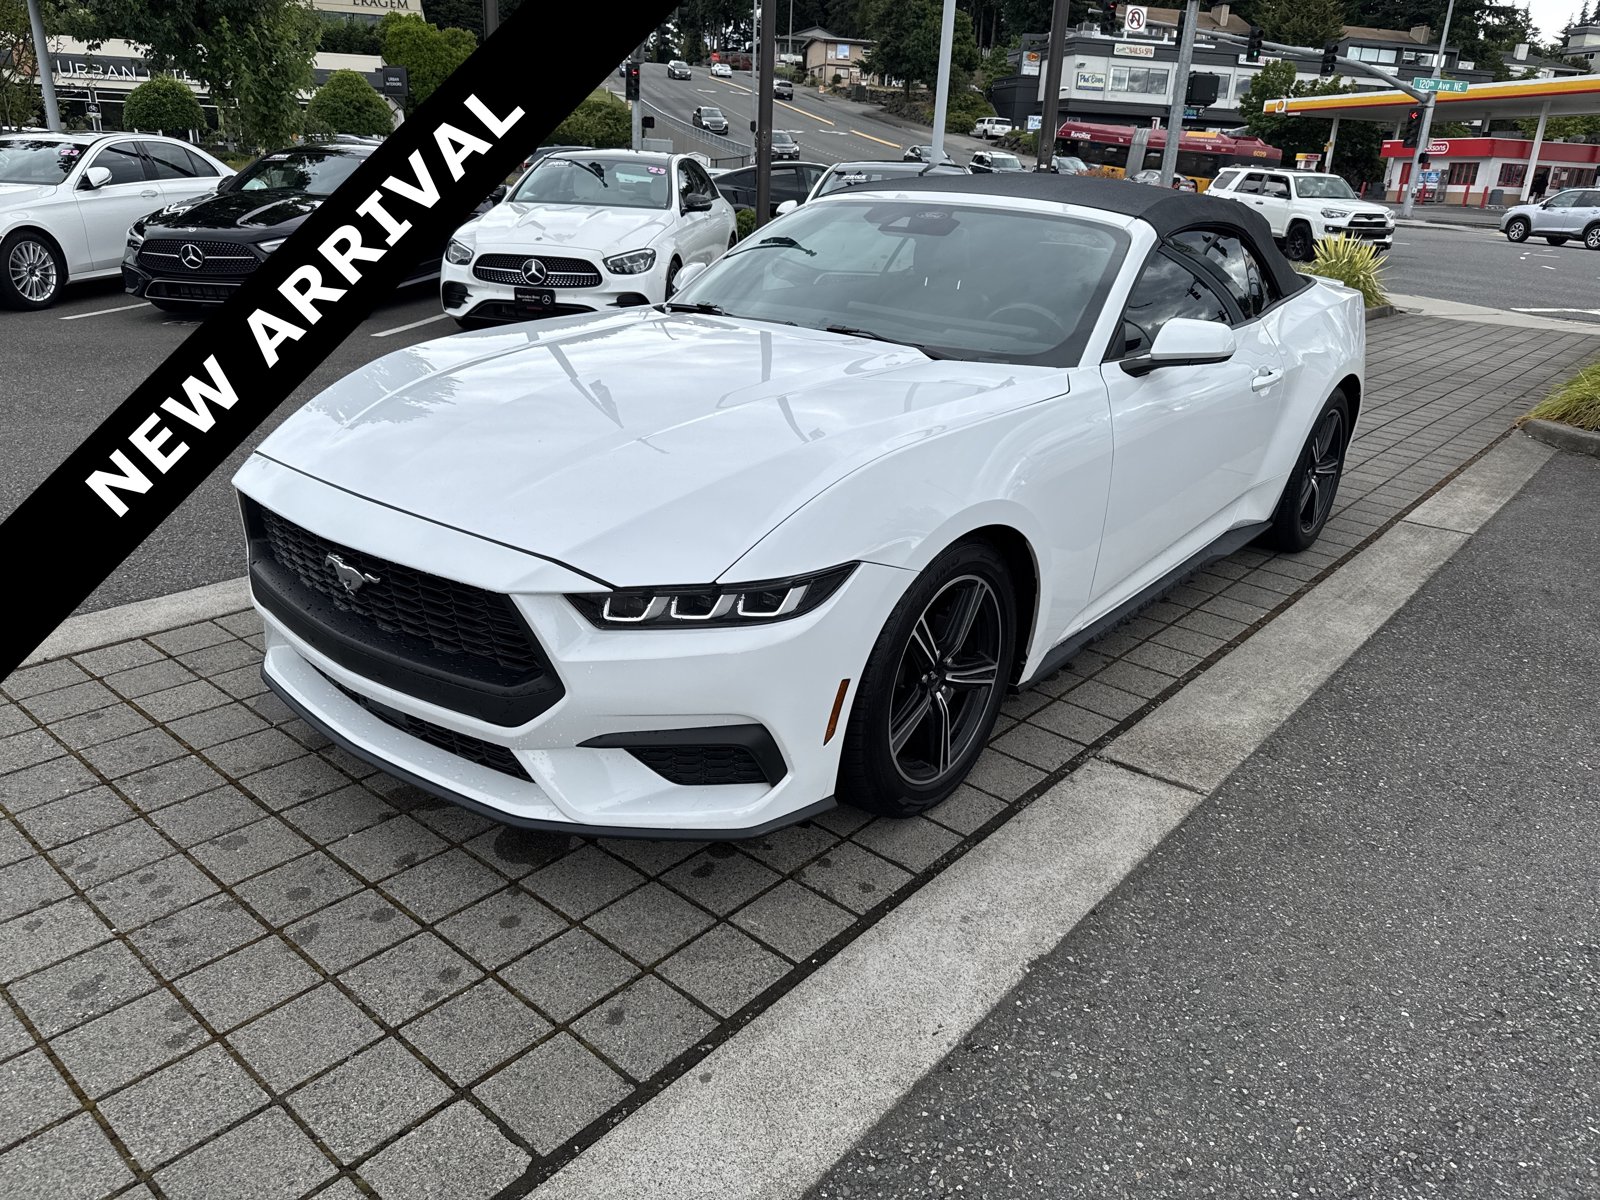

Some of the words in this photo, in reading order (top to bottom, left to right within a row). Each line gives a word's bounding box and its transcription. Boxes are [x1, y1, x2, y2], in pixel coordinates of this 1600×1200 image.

[57, 59, 136, 81] URBAN
[1438, 81, 1450, 90] Ave
[1454, 83, 1462, 91] NE
